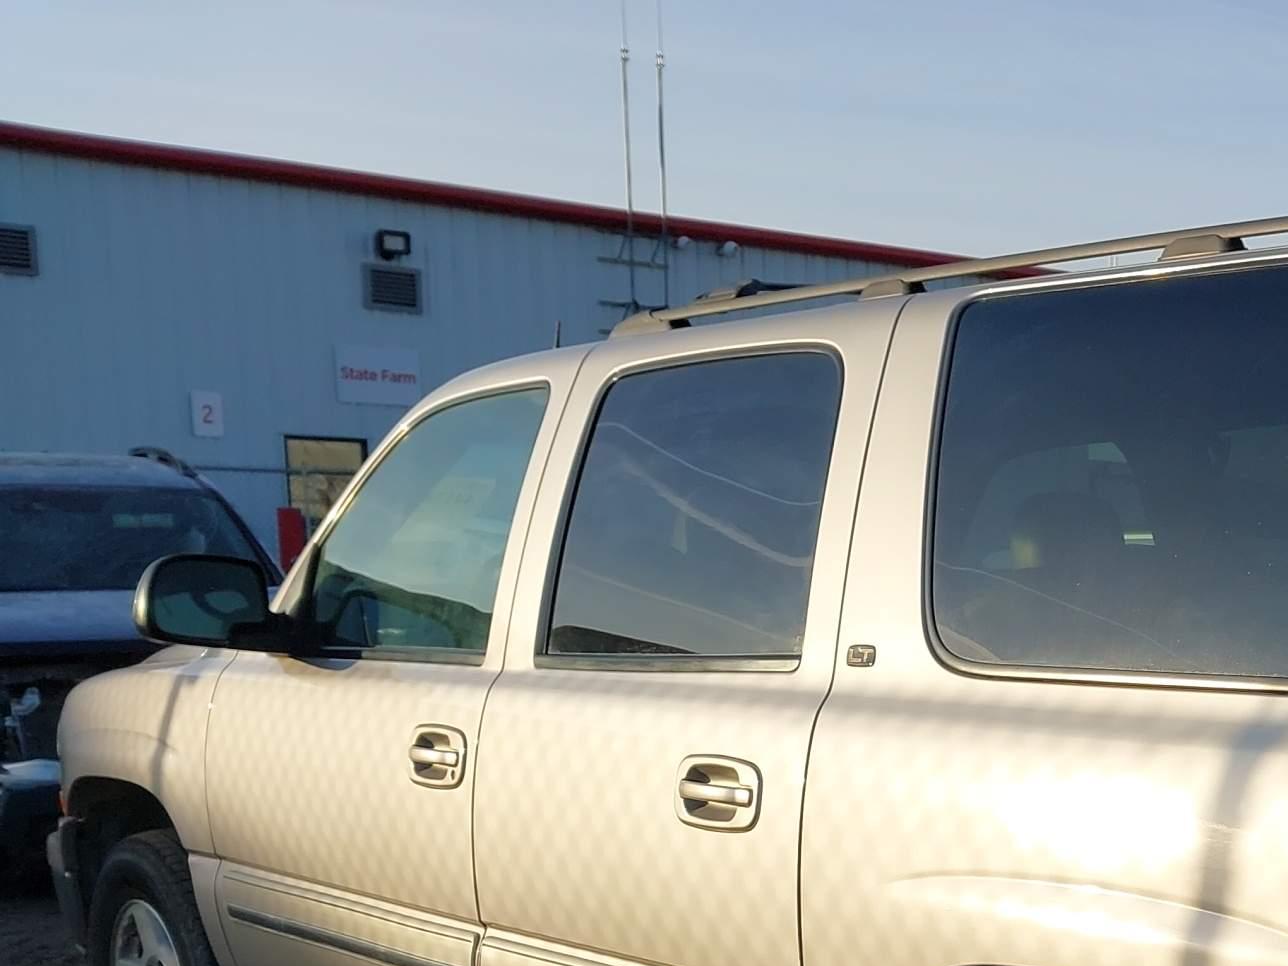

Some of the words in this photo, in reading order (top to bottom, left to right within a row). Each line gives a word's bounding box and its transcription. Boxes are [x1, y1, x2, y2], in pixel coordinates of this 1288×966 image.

[340, 366, 377, 382] State
[381, 369, 416, 384] Farm
[202, 404, 213, 424] 2
